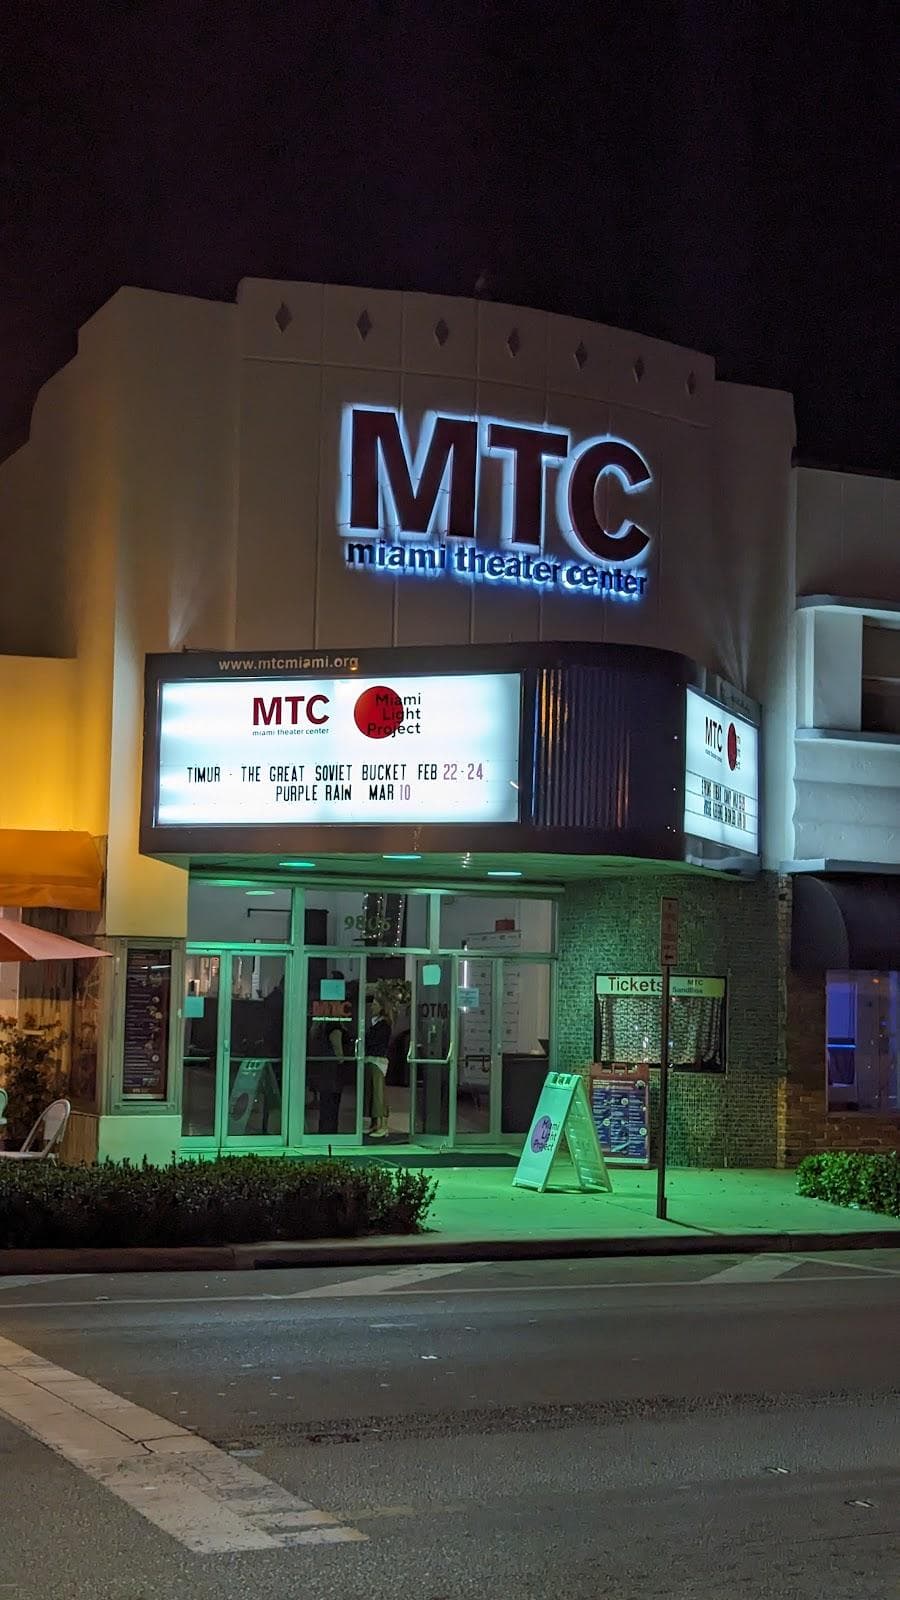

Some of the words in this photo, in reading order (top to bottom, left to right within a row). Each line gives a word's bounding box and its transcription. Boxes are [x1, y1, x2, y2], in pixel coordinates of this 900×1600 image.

[350, 409, 650, 561] MTC
[347, 540, 446, 569] miami
[455, 546, 561, 584] theater
[565, 563, 647, 596] center
[218, 655, 359, 671] www.mtcmiami.org
[375, 692, 421, 706] Miami
[252, 694, 330, 726] MTC
[382, 707, 421, 723] Light
[277, 728, 304, 736] theater
[367, 722, 421, 738] Project
[705, 716, 723, 752] MTC
[187, 766, 221, 783] TIMUR
[241, 766, 261, 782] THE
[269, 765, 305, 782] GREAT
[315, 764, 353, 782] SOVIET
[362, 763, 407, 781] BUCKET
[417, 763, 438, 781] FEB
[276, 785, 318, 802] PURPLE
[325, 784, 352, 801] RAIN
[369, 784, 394, 801] MAR
[399, 784, 411, 801] 10
[608, 977, 663, 992] Tickets
